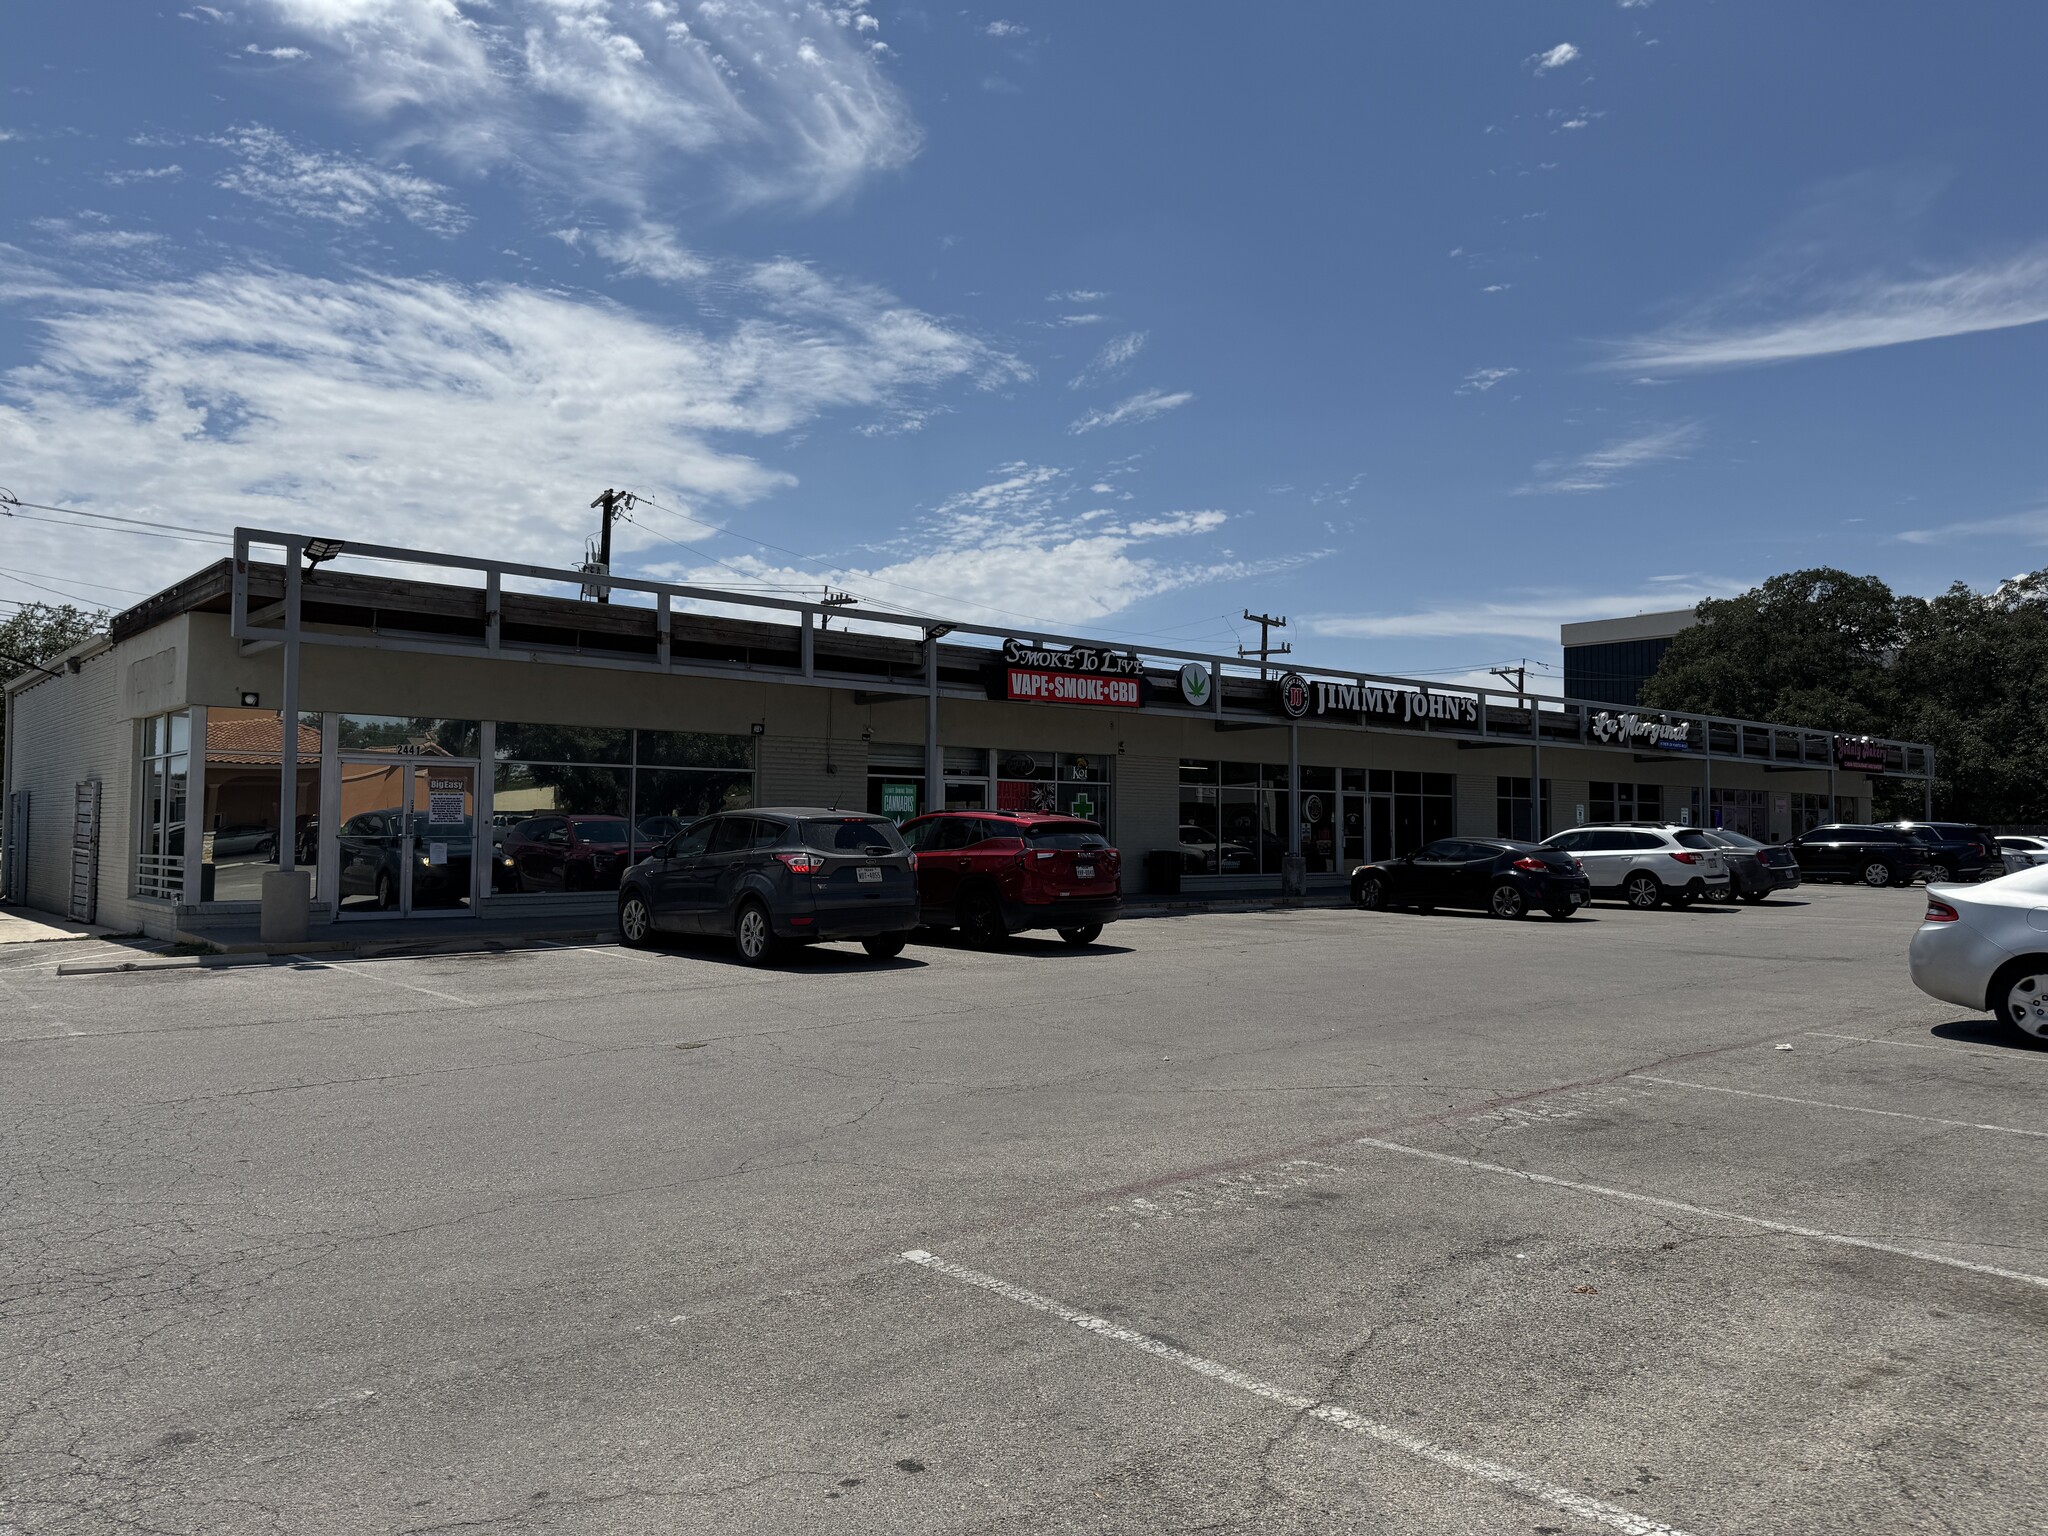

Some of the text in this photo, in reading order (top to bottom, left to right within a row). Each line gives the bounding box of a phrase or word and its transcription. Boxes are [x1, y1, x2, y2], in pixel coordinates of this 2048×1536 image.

[1011, 673, 1138, 703] VAPE SMOKE CBD
[1290, 687, 1303, 706] JJ
[1317, 683, 1399, 714] JIMMY
[1404, 692, 1477, 722] JOHN'S
[1592, 711, 1690, 745] La Marginal
[397, 745, 420, 755] 2441
[1861, 738, 1887, 764] Bakery
[1072, 765, 1088, 780] Koi
[883, 795, 914, 812] CANNABIS
